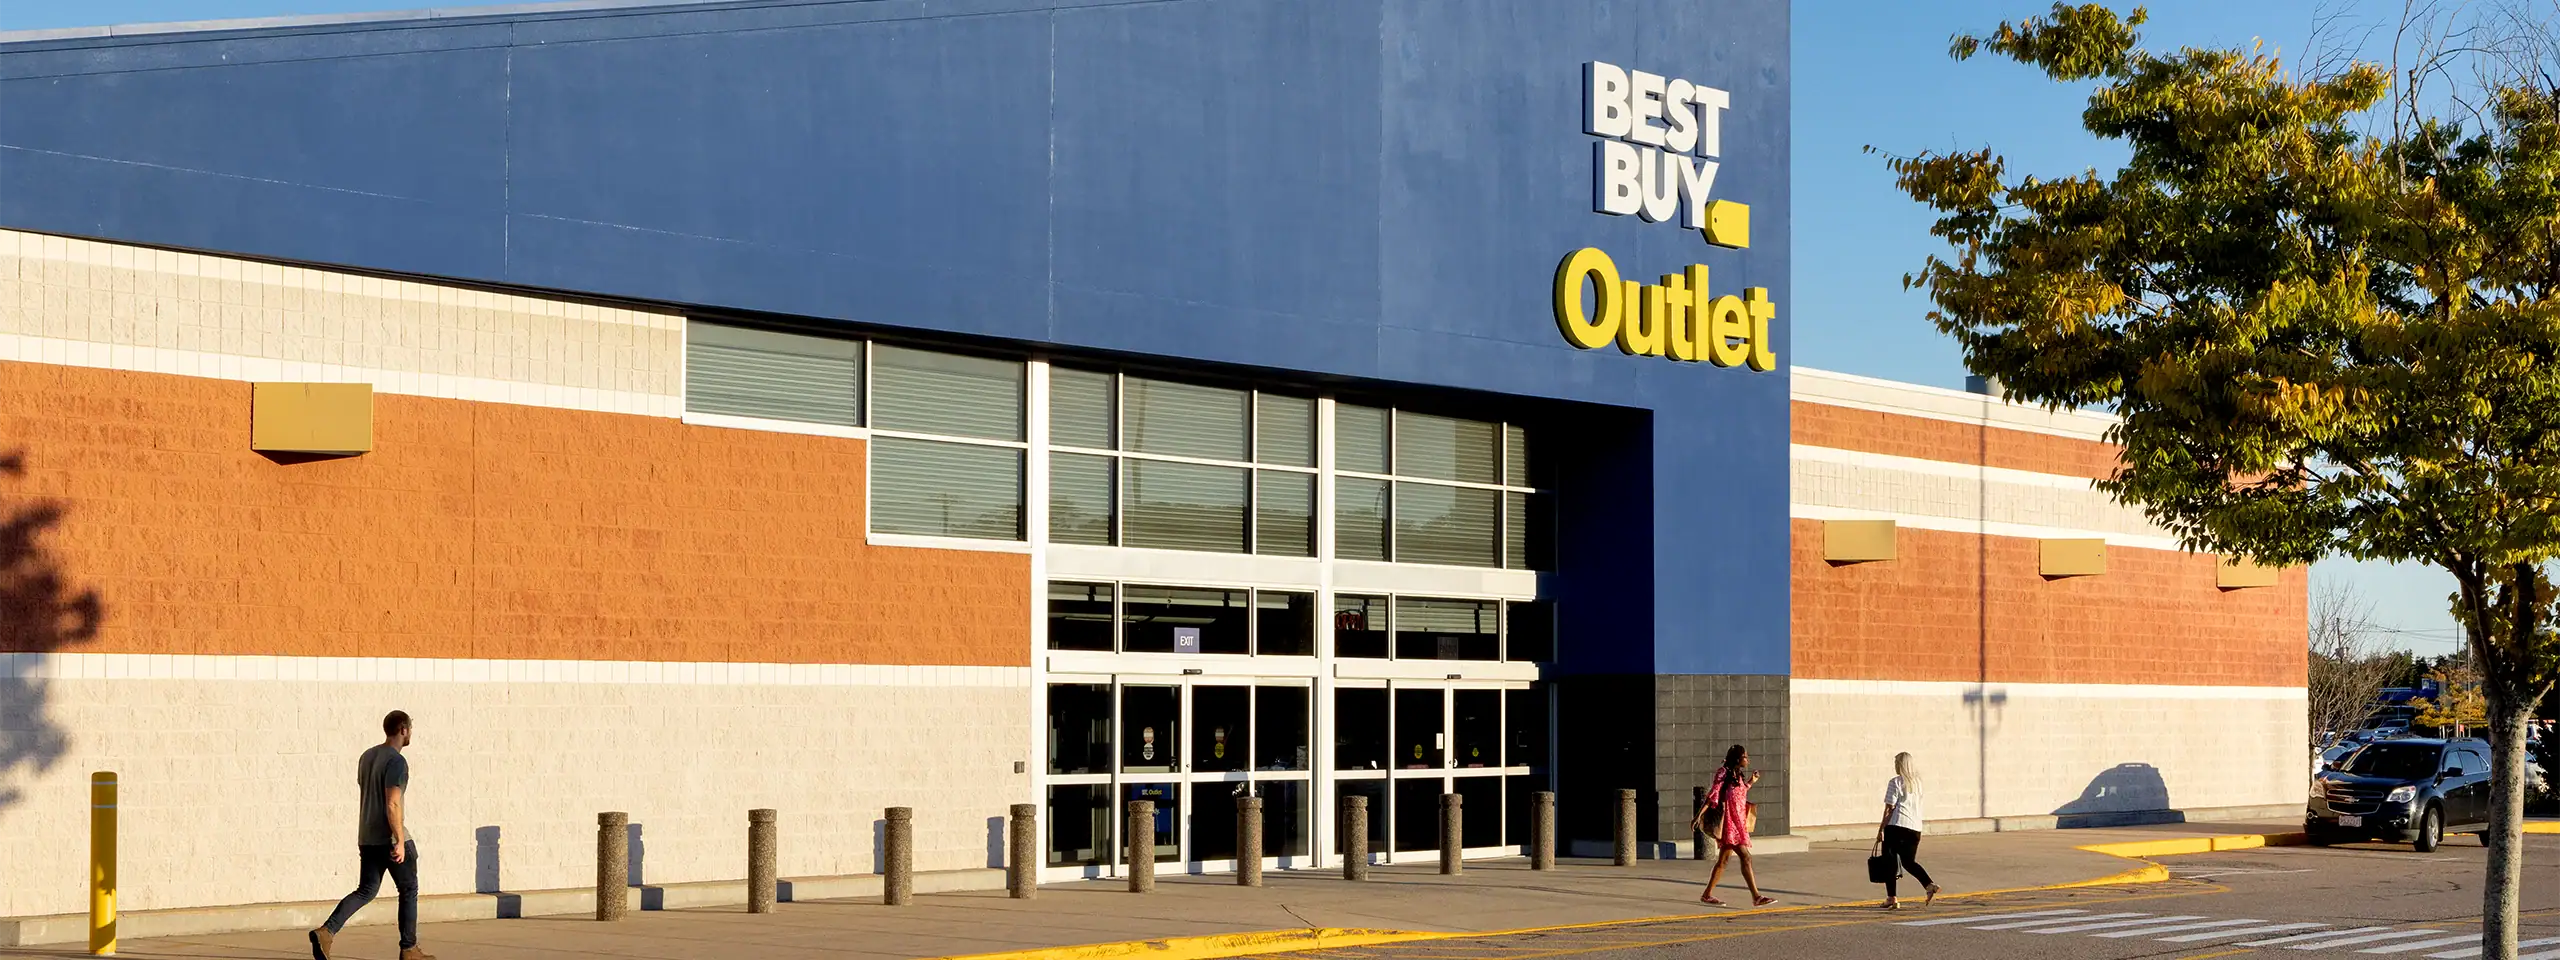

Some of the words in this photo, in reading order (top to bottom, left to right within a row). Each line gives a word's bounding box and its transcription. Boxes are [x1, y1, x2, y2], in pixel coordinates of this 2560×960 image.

[1583, 60, 1730, 158] BEST
[1594, 140, 1720, 230] BUY
[1553, 247, 1776, 372] Outlet
[1180, 636, 1194, 646] EXIT
